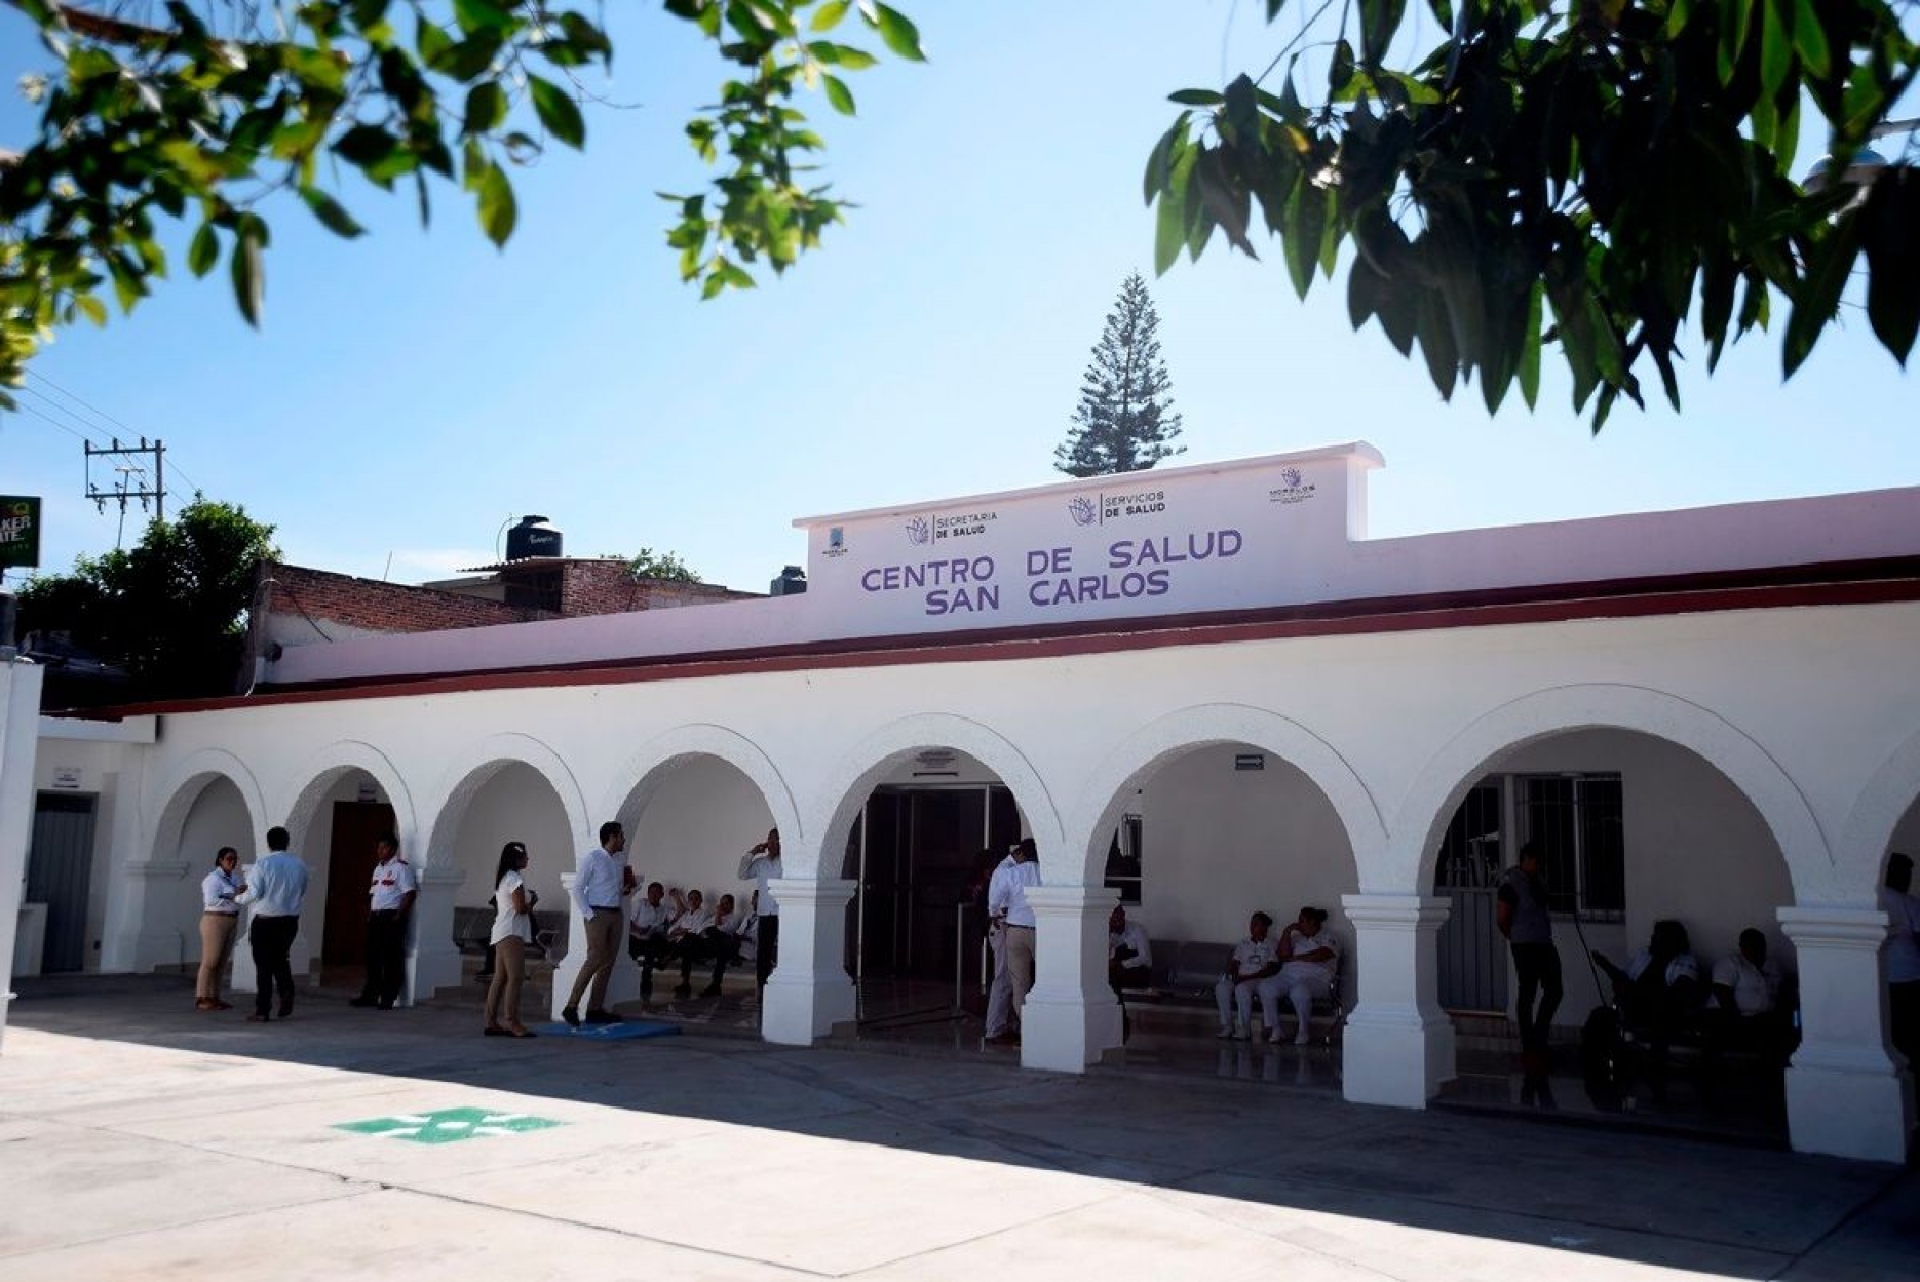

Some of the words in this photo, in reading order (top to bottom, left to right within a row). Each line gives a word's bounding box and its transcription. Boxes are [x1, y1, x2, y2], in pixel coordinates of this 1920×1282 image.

[1105, 491, 1164, 507] SERVICIOS
[1105, 508, 1119, 517] DE
[1126, 502, 1165, 515] SALUD
[937, 512, 998, 528] SECRETARIA
[936, 531, 948, 539] DE
[953, 525, 986, 537] SALUD
[861, 556, 995, 592] CENTRO
[1027, 547, 1072, 576] DE
[1109, 529, 1242, 568] SALUD
[925, 585, 1000, 616] SAN
[1029, 570, 1169, 607] CARLOS
